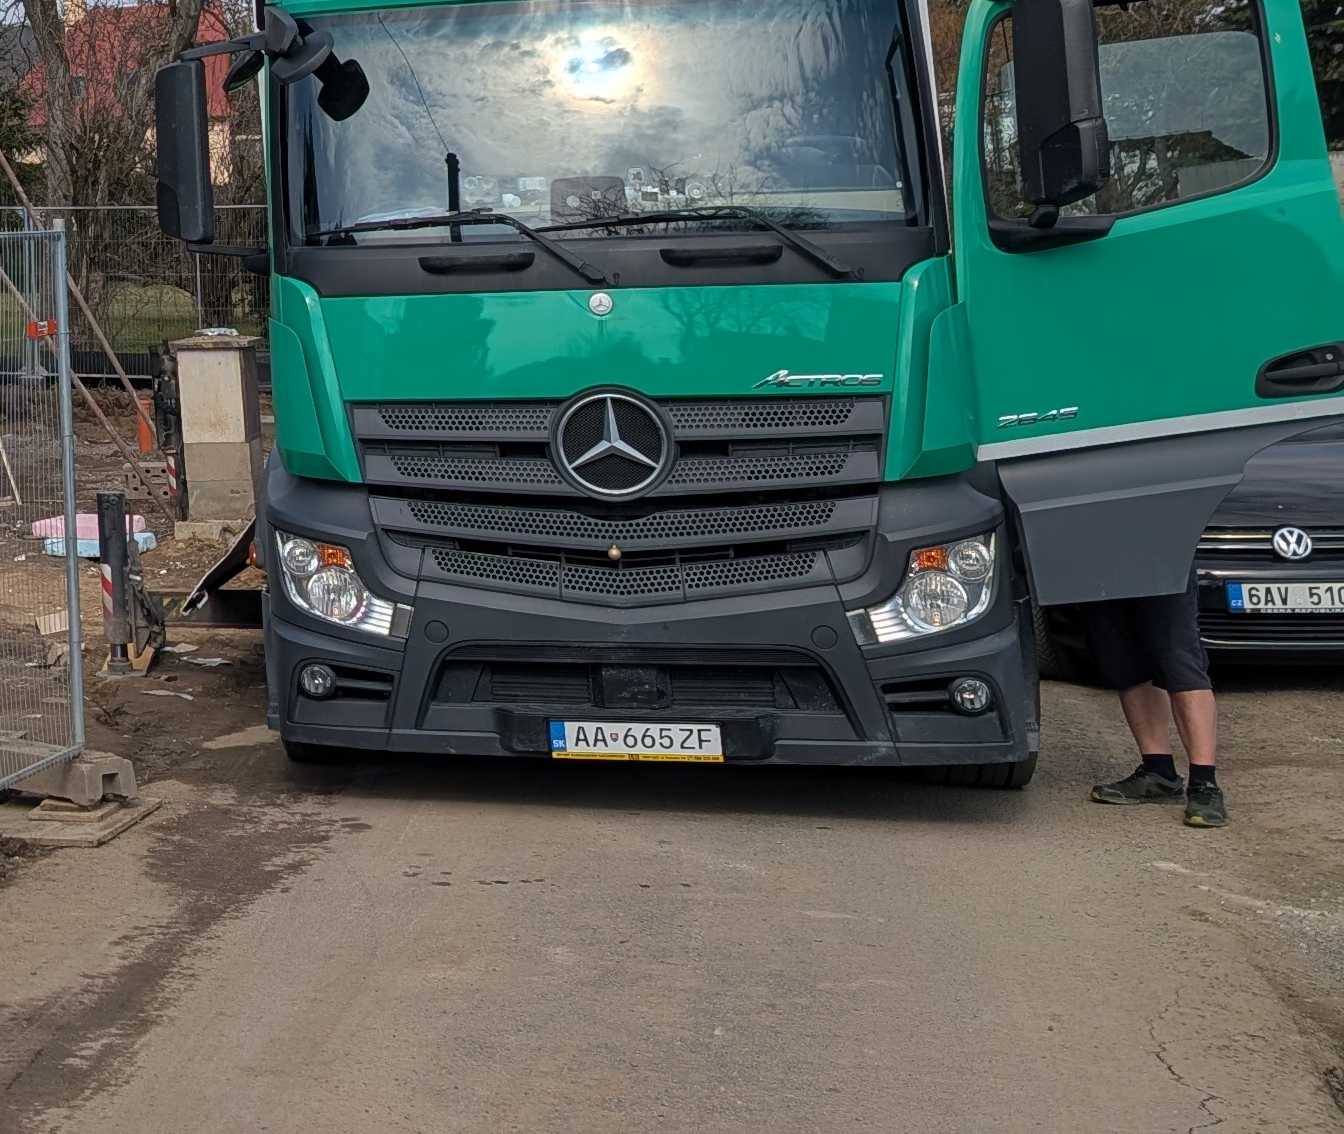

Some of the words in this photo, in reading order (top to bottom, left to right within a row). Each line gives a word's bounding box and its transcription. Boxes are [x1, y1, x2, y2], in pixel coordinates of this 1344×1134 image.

[997, 406, 1079, 429] 2645
[1230, 599, 1243, 607] CZ
[1247, 586, 1289, 607] 6AV
[552, 739, 566, 748] SK
